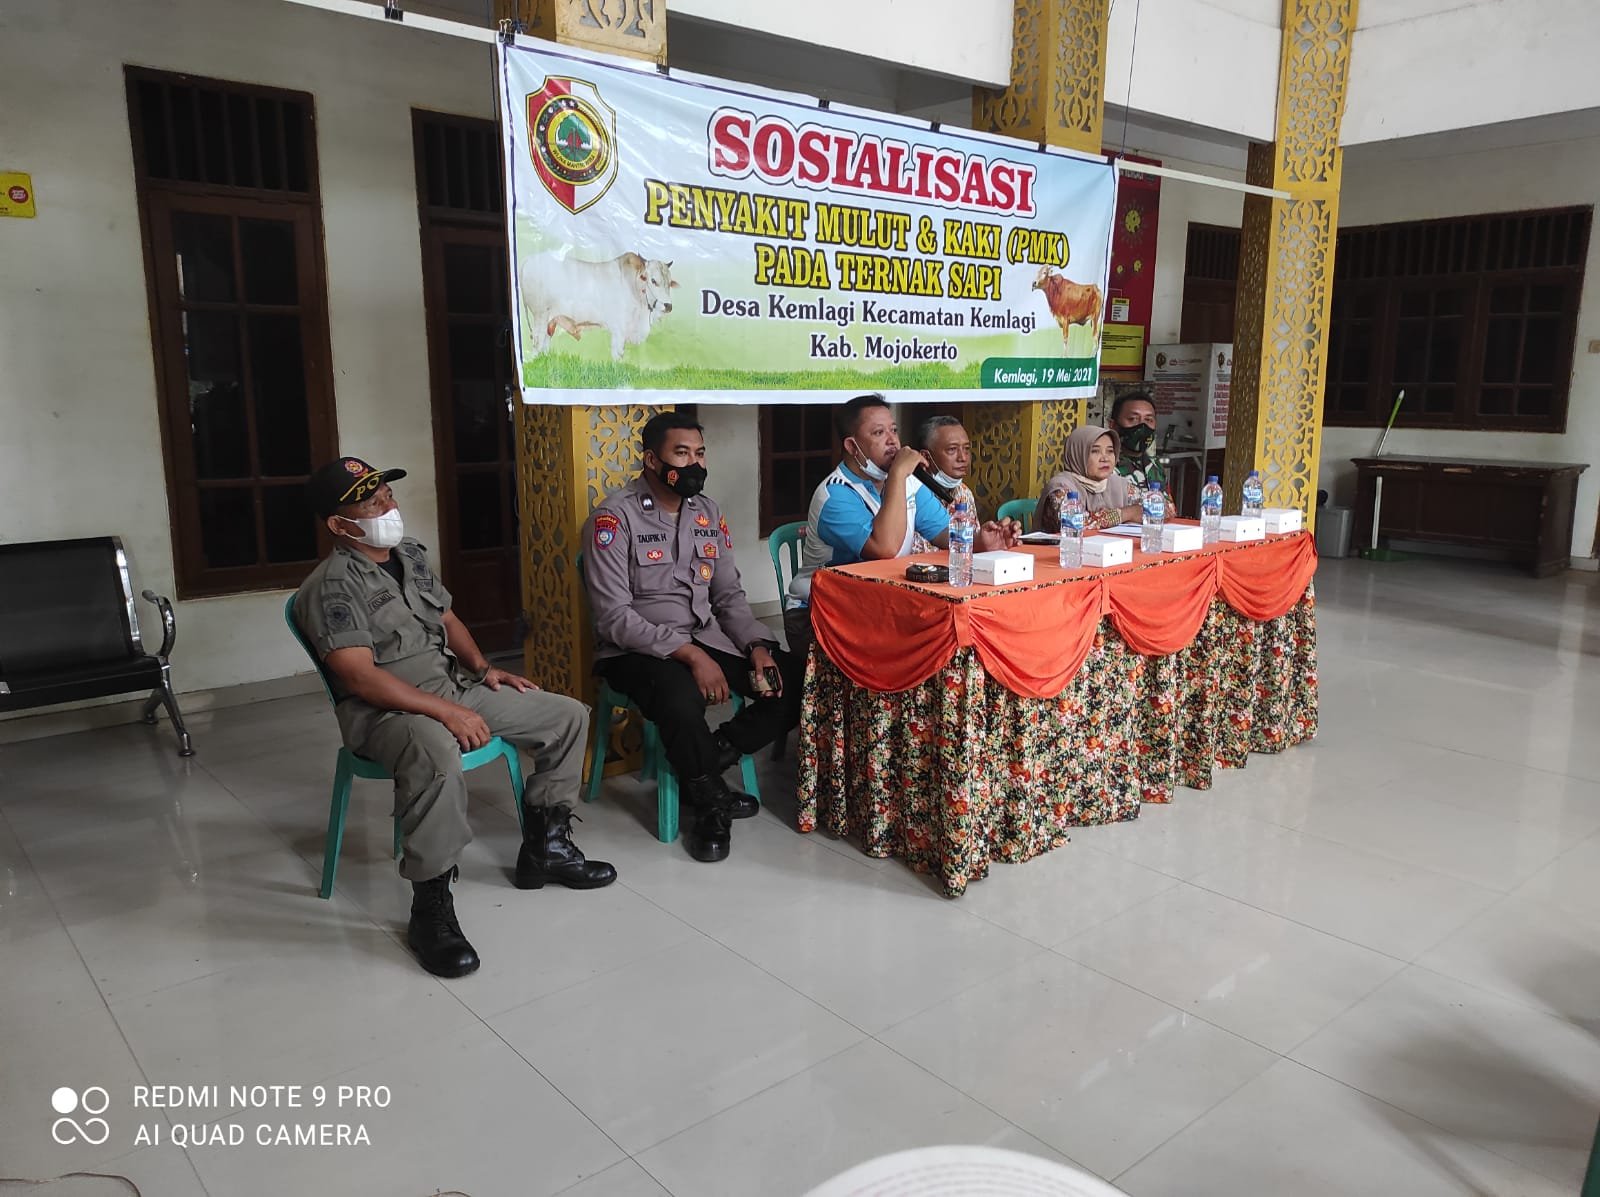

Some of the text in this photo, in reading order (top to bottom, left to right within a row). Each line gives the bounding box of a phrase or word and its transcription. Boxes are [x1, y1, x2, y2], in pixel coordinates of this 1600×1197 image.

[711, 111, 1034, 214] SOSIALISASI
[645, 179, 1070, 268] PENYAKIT MULUT & KAKI (PMK)
[755, 243, 1002, 301] PADA TERNAK SAPI
[701, 289, 1036, 333] Desa Kemlagi Kecamatan Kemlagi
[811, 334, 958, 364] Kab. Mojokerto
[994, 368, 1038, 386] Kemlagi,
[1041, 368, 1055, 383] 19
[1056, 368, 1072, 382] Mei
[694, 528, 718, 537] POLRI
